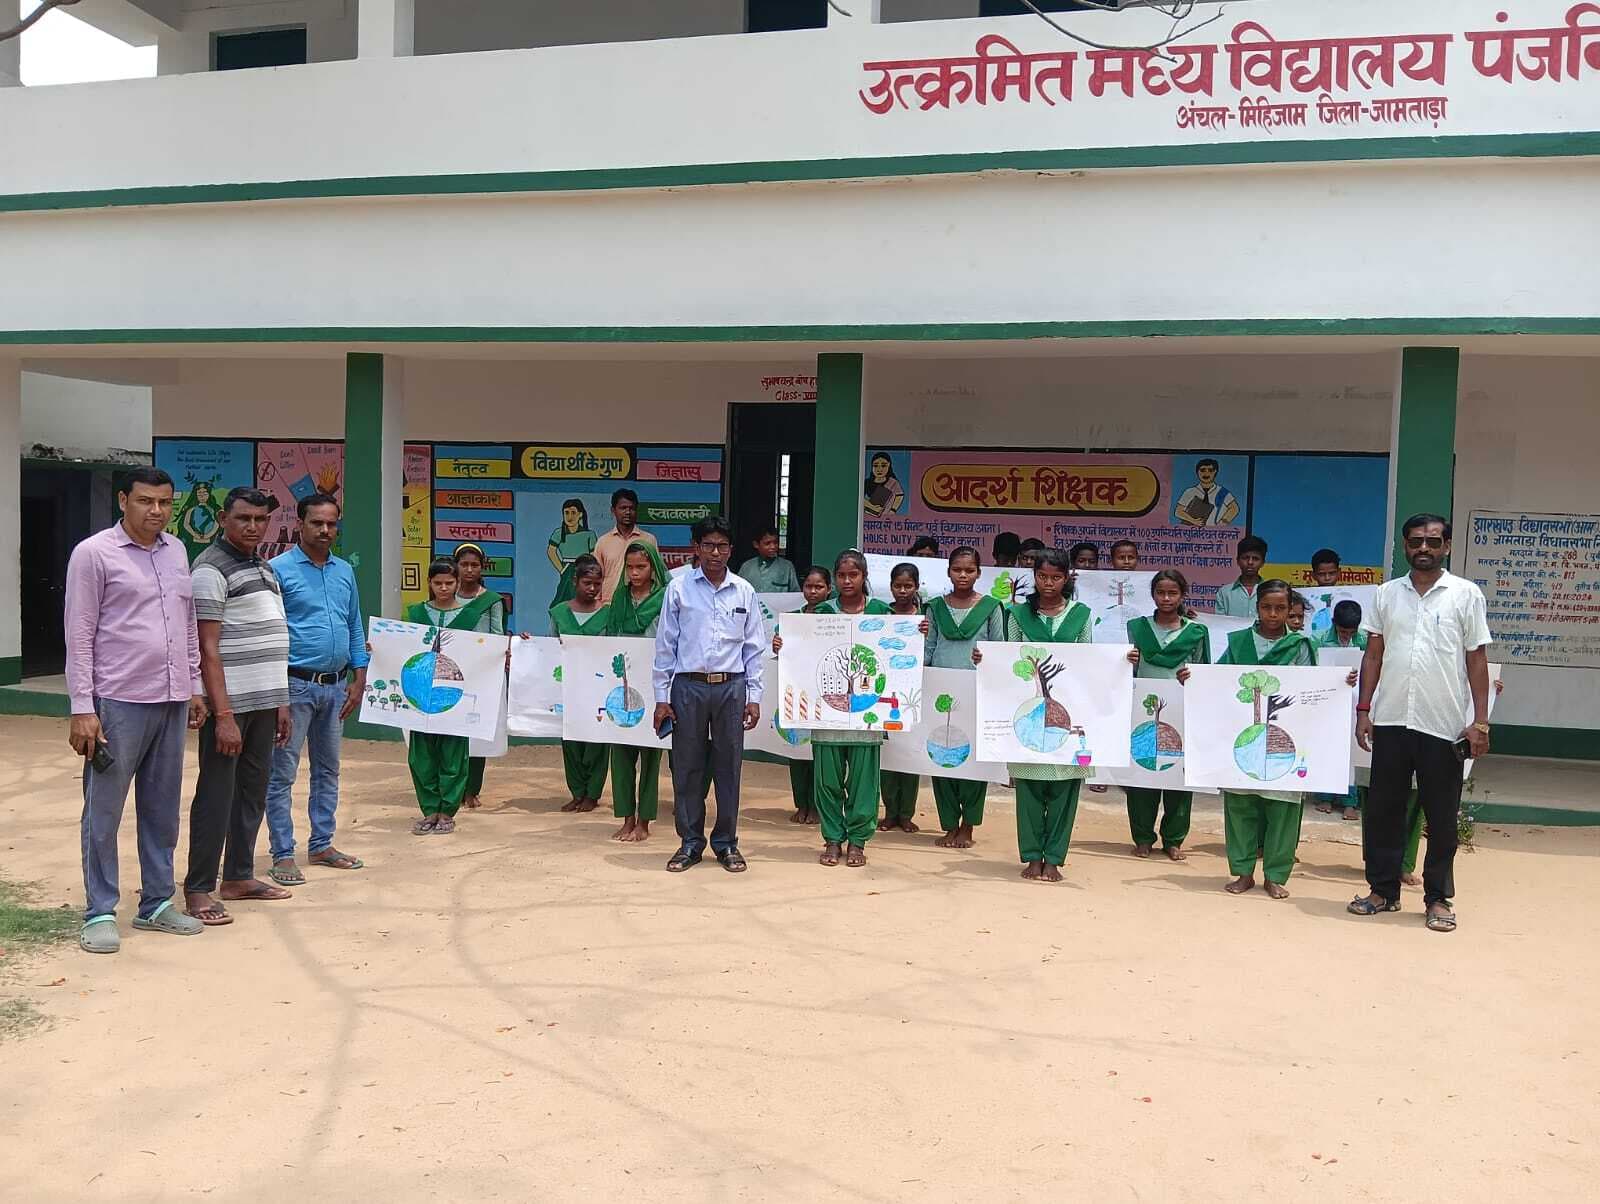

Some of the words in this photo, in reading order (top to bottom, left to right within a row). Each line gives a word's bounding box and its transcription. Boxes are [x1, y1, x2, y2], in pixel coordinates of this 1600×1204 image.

[859, 34, 1078, 114] उत्क्रमित
[1085, 45, 1218, 98] मध्य
[1224, 20, 1453, 93] विद्यालय
[891, 535, 912, 545] DUTY
